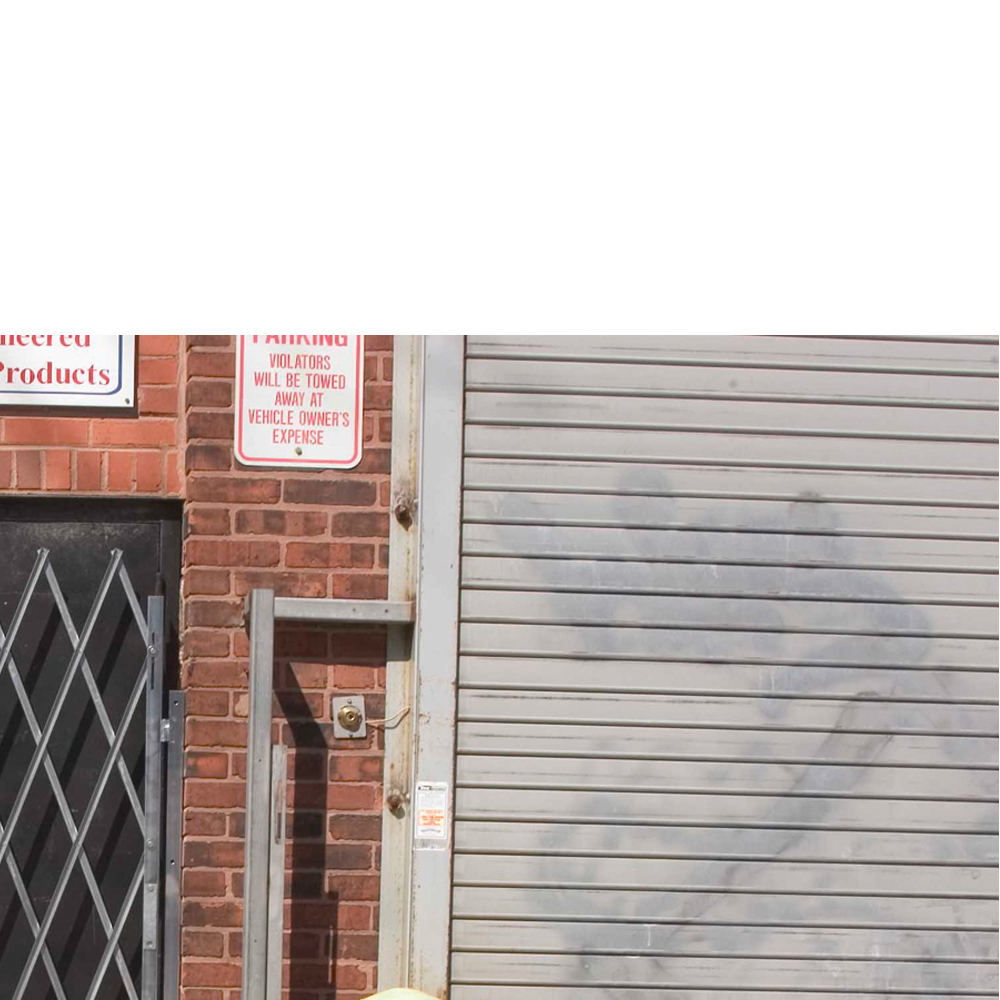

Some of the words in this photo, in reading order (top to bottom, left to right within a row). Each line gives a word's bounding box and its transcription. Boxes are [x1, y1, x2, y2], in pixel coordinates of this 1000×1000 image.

[269, 353, 331, 370] VIOLATORS
[254, 371, 281, 387] WILL
[286, 372, 300, 388] BE
[306, 373, 346, 389] TOWED
[274, 391, 305, 406] AWAY
[310, 392, 324, 407] AT
[248, 409, 294, 425] VEHICLE
[299, 411, 350, 427] OWNER'S
[272, 428, 324, 445] EXPENSE
